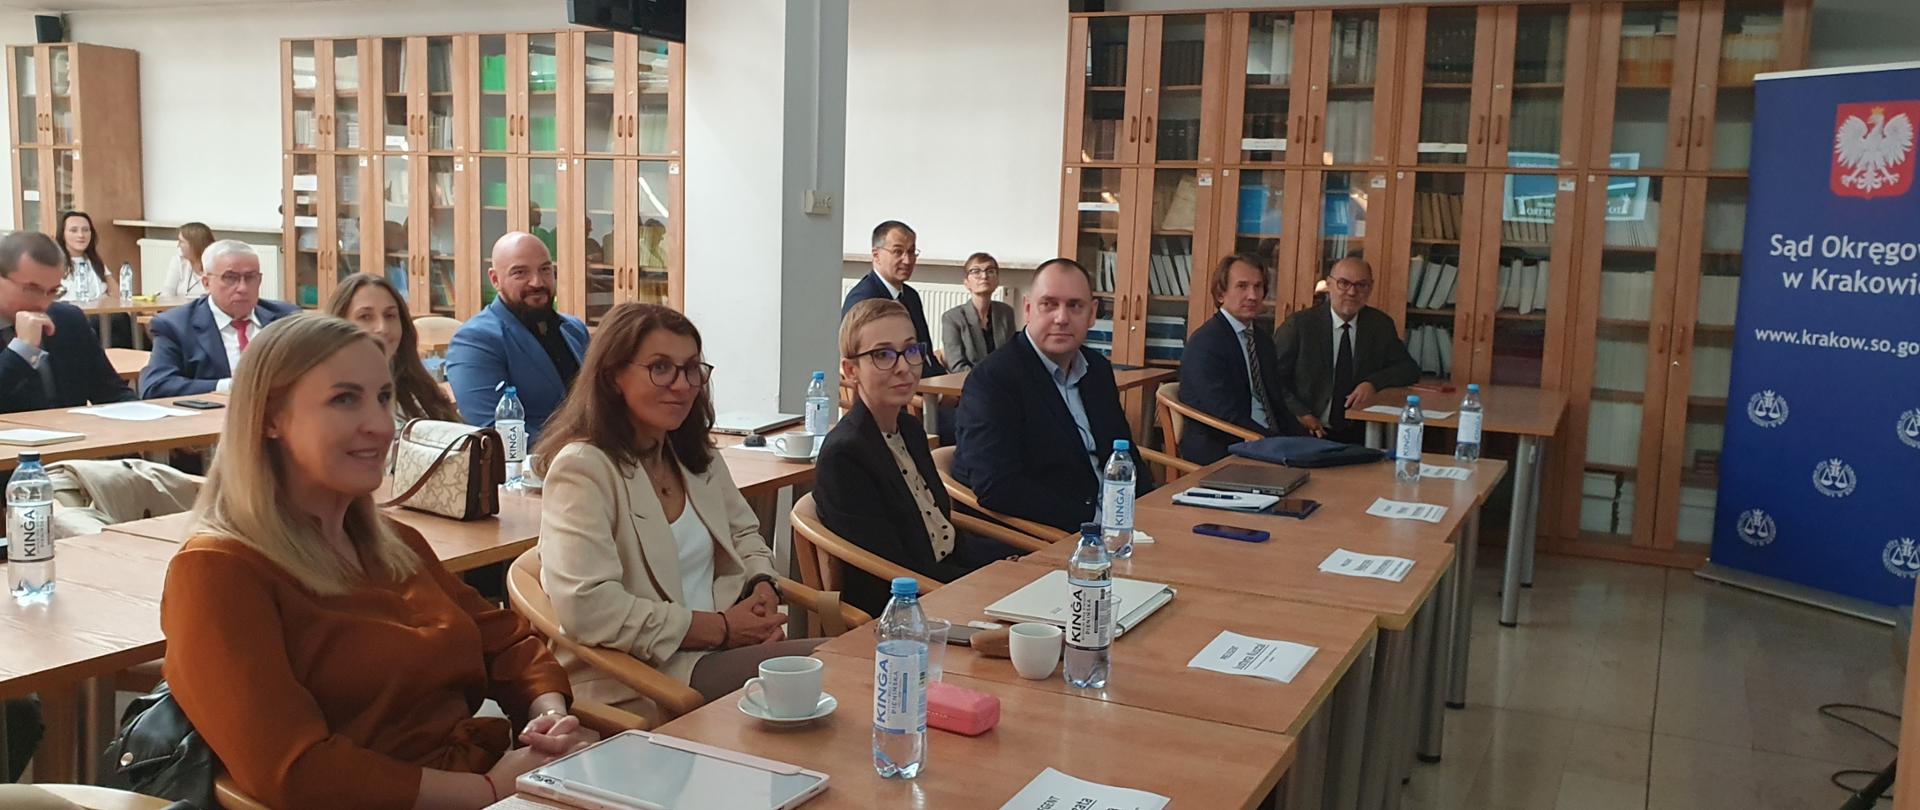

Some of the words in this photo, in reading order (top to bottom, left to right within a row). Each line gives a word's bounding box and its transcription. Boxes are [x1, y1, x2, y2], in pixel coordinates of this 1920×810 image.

[1770, 233, 1814, 262] Sąd
[1821, 235, 1920, 266] Okręgo
[1782, 271, 1803, 289] w
[1811, 267, 1920, 296] Krakowi
[1755, 328, 1920, 358] www.krakow.so.go
[508, 426, 517, 459] KINGA
[1115, 487, 1125, 526] KINGA
[22, 509, 36, 557] KINGA
[1070, 589, 1083, 643] KINGA
[876, 658, 889, 723] KINGA
